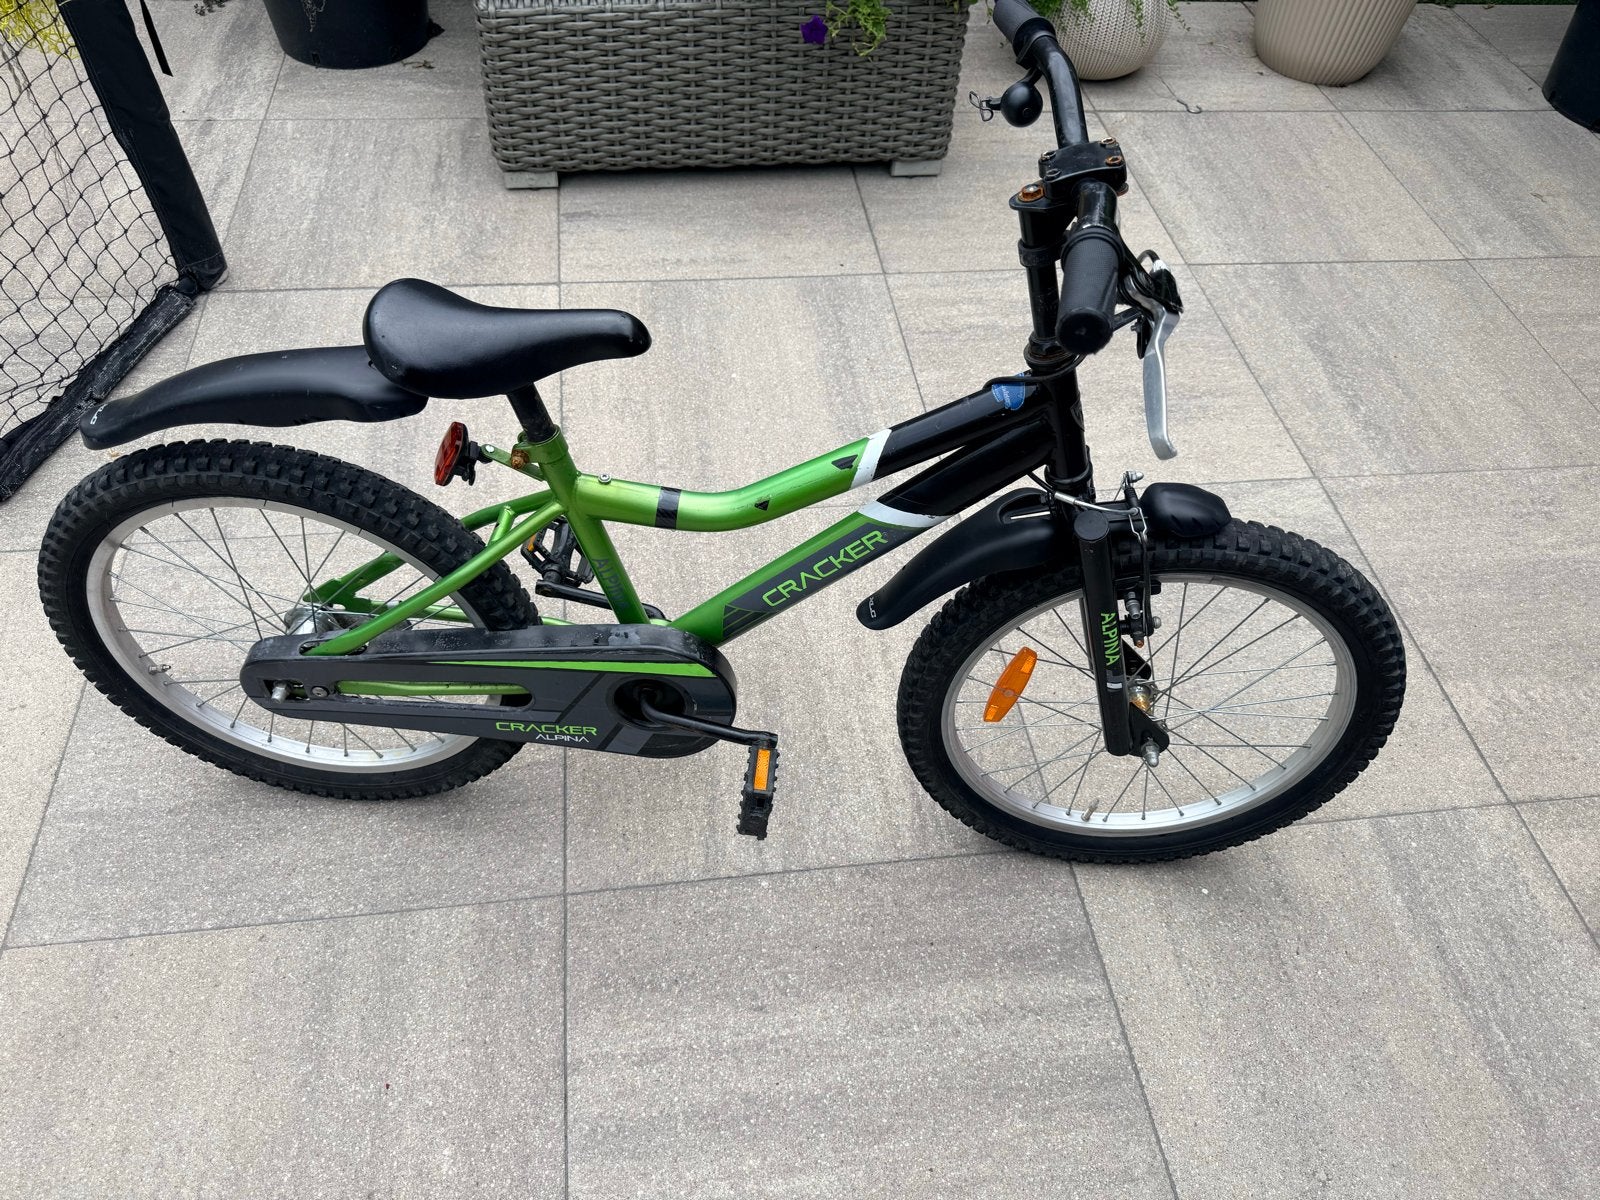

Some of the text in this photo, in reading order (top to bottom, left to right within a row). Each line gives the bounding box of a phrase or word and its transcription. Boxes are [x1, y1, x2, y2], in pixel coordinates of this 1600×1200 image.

[762, 530, 888, 607] CRACKER
[1100, 612, 1120, 666] ALPINA
[495, 721, 598, 736] CRACKER
[535, 733, 589, 743] ALPINA
